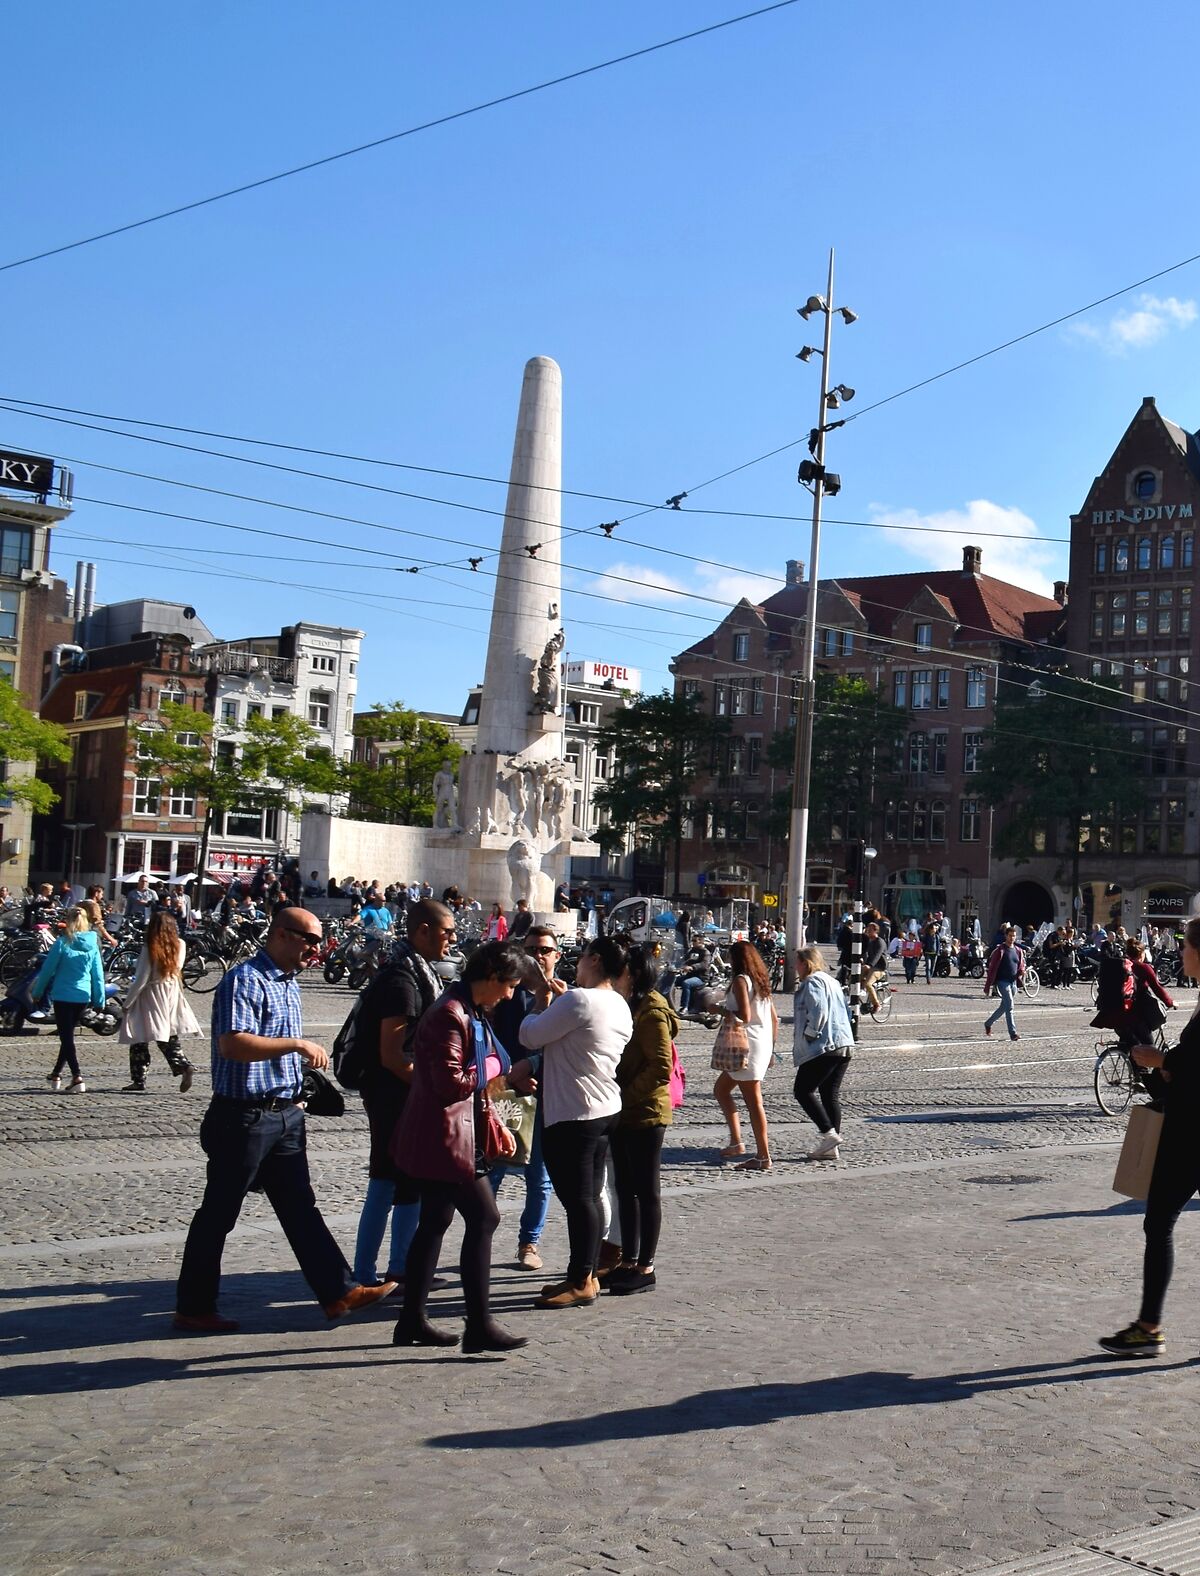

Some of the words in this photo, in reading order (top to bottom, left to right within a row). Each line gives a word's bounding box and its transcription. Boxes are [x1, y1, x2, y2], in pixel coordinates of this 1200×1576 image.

[0, 459, 40, 484] KY
[594, 663, 628, 680] HOTEL
[1148, 898, 1184, 906] SVNRS
